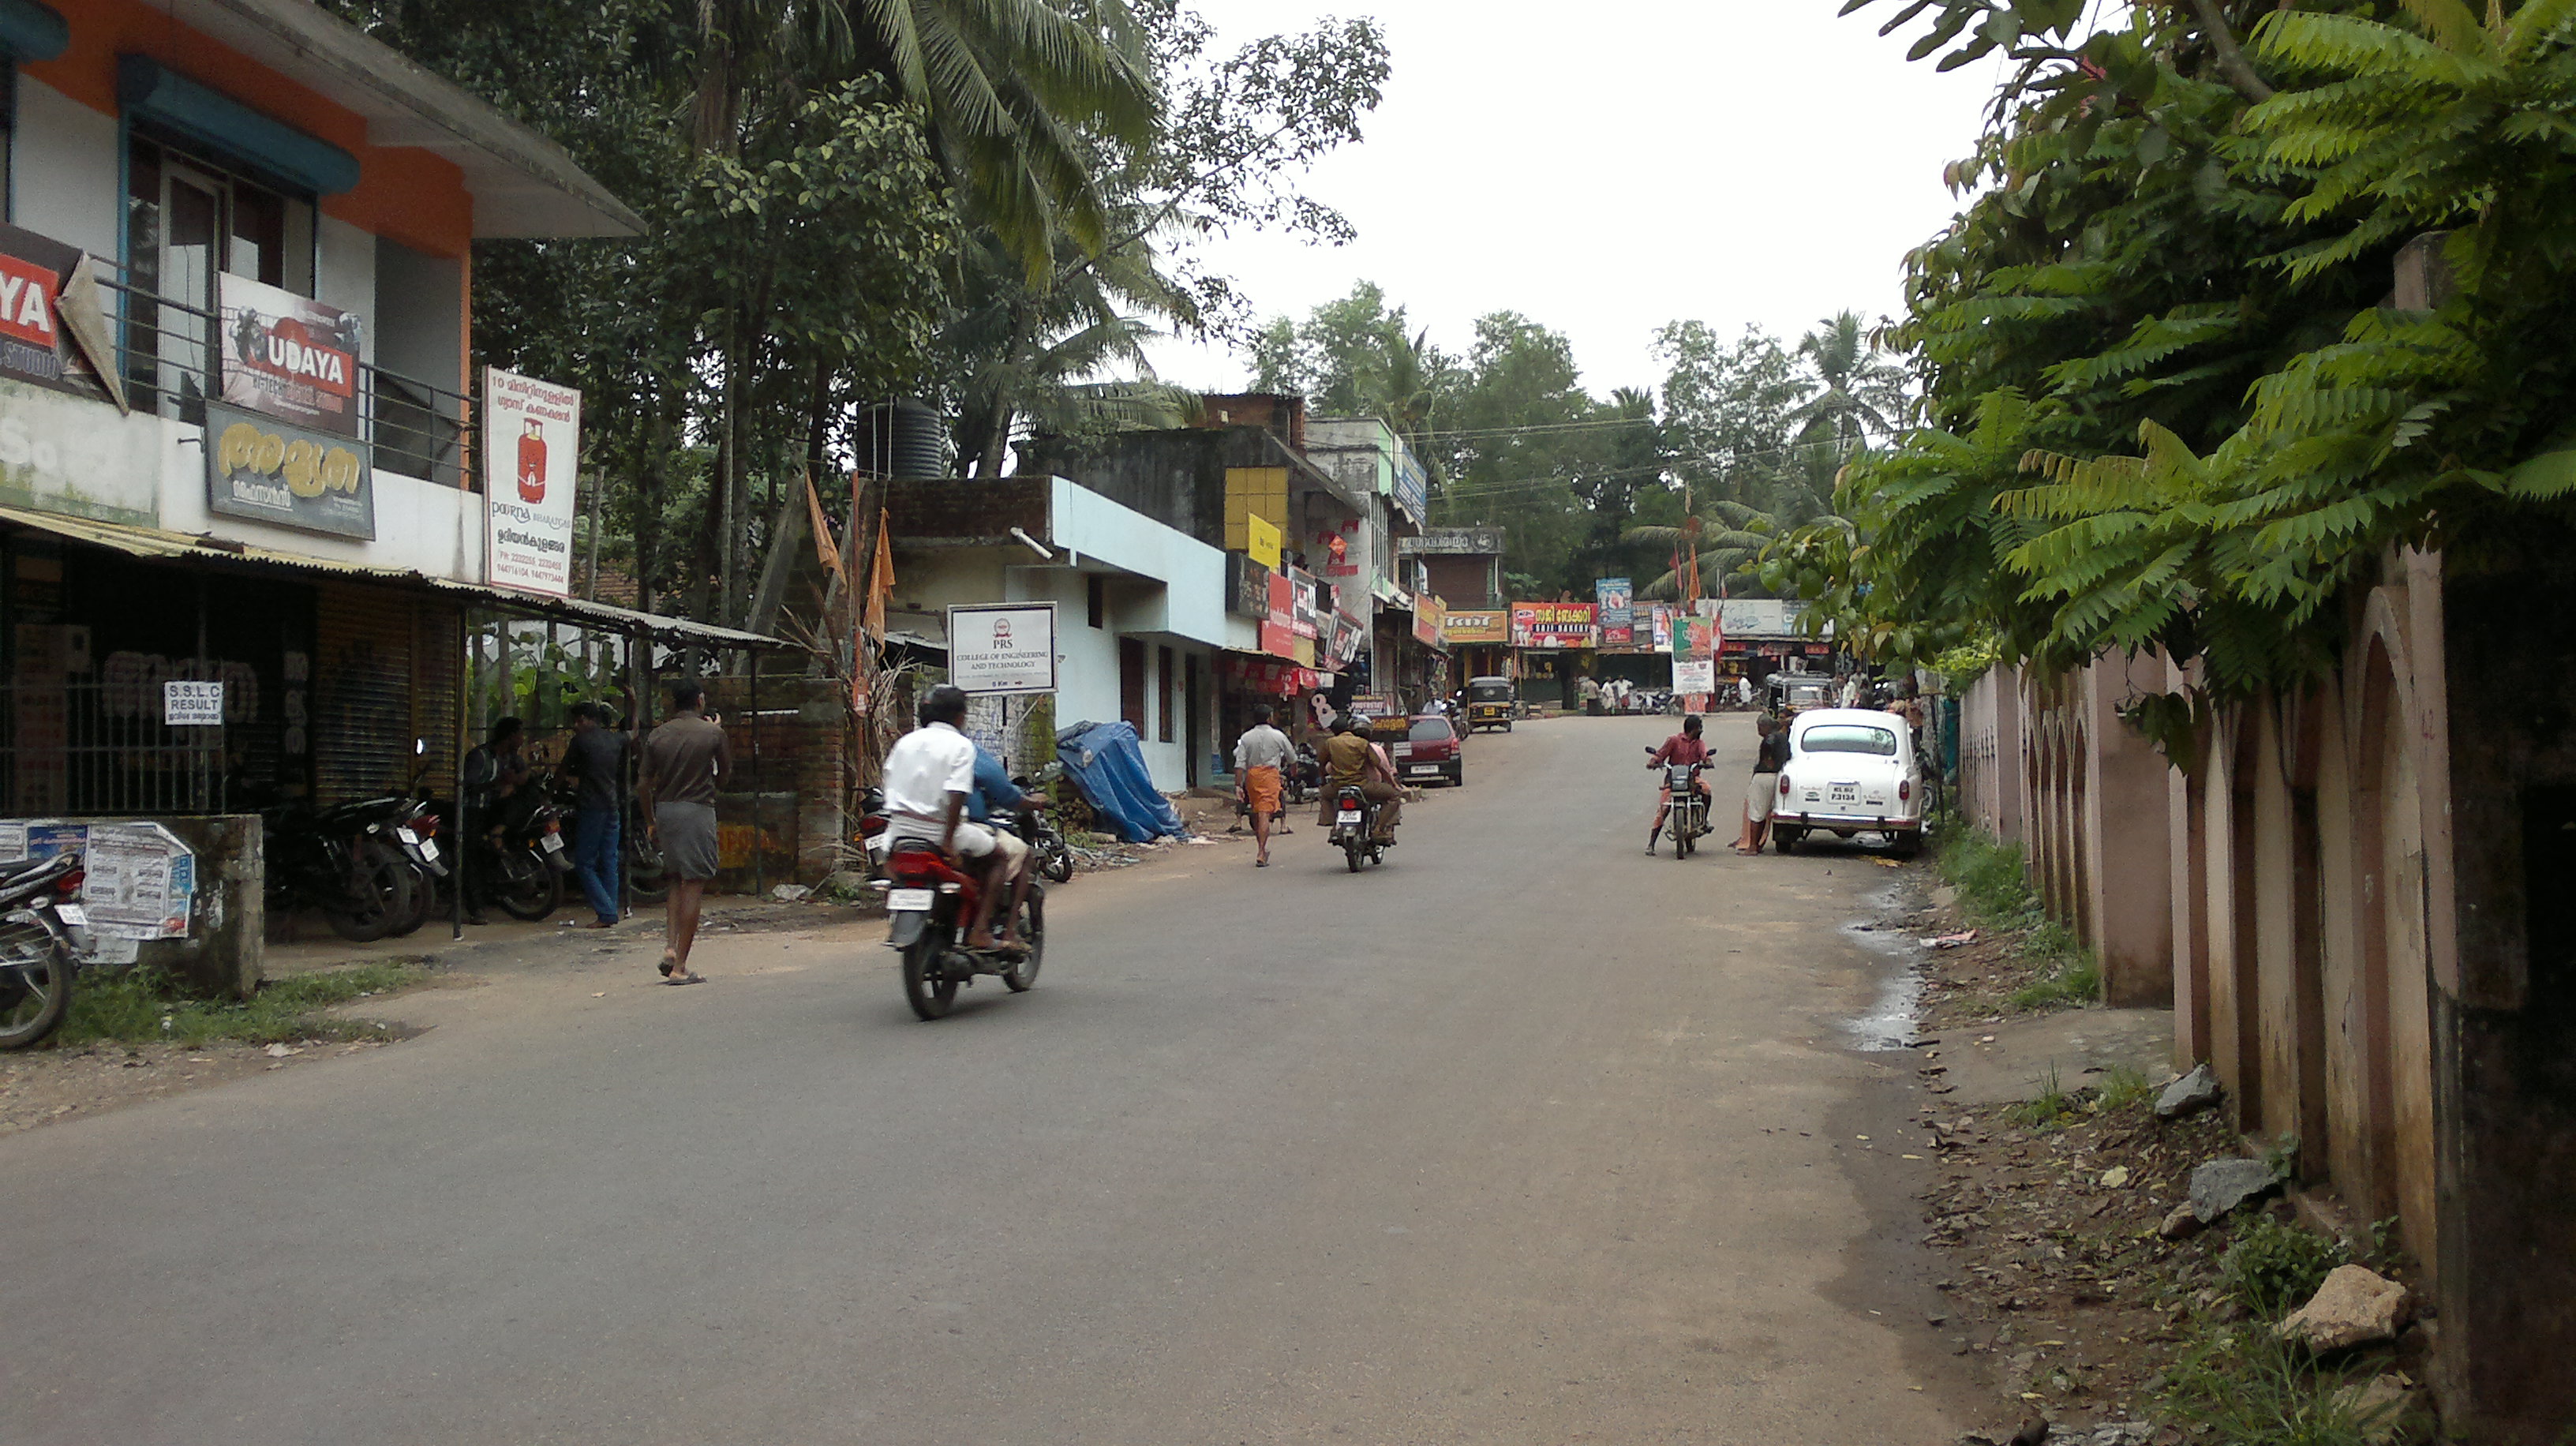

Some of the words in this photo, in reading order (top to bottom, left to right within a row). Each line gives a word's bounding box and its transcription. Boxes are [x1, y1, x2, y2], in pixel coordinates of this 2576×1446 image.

[4, 341, 62, 380] STUDIO
[268, 335, 344, 385] UDAYA
[492, 376, 504, 388] 10
[993, 639, 1013, 650] PRS
[957, 652, 989, 661] COLLEGE
[990, 652, 1000, 661] OF
[1001, 650, 1049, 659] ENGINEERING
[971, 661, 987, 670] AND
[988, 661, 1036, 670] TECHNOLOGY
[170, 699, 219, 710] RESULT
